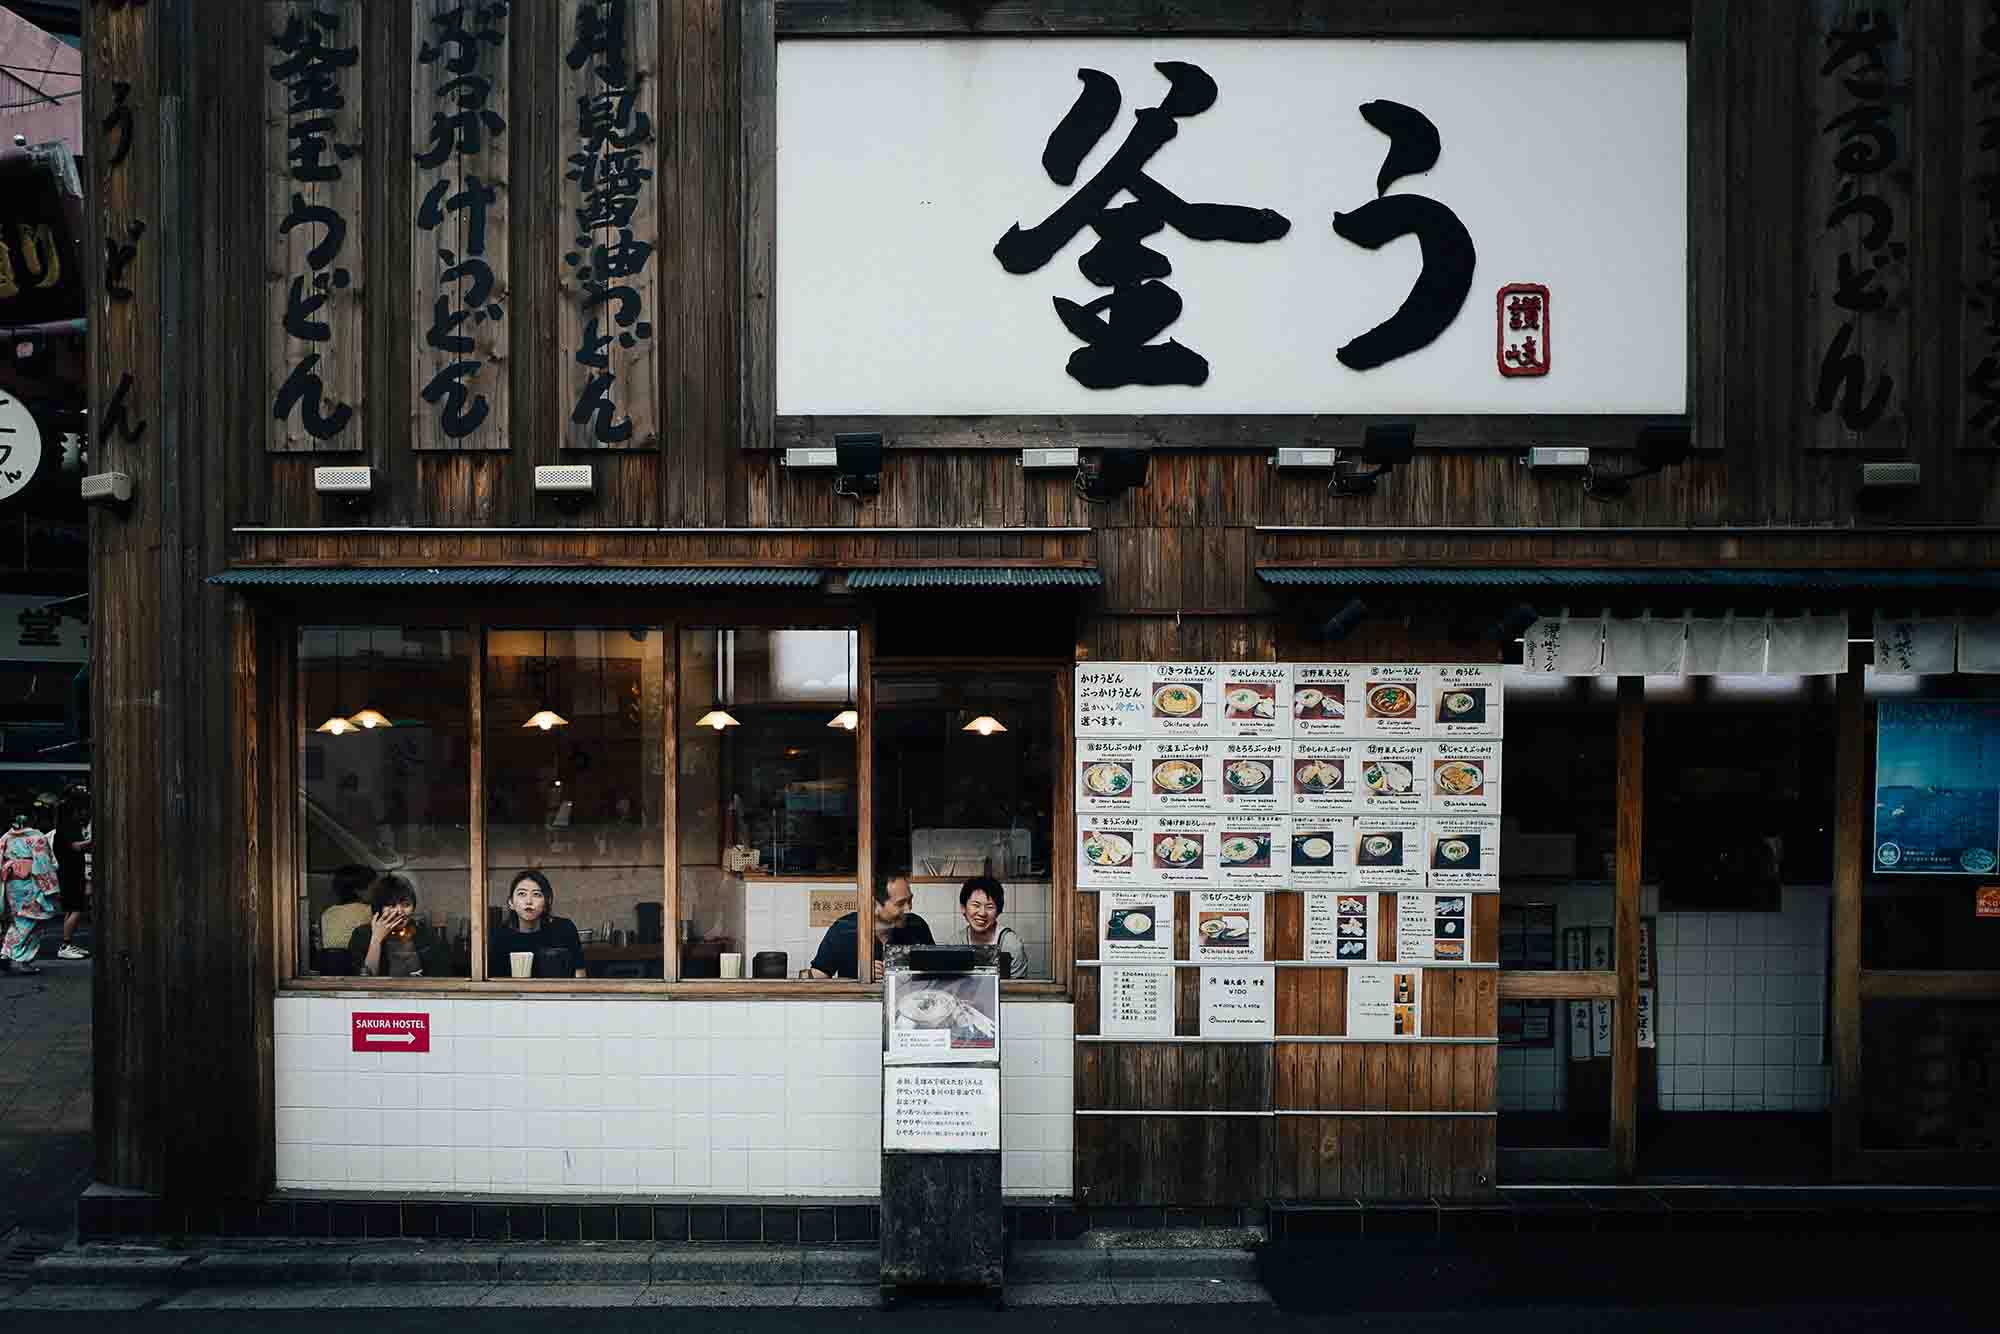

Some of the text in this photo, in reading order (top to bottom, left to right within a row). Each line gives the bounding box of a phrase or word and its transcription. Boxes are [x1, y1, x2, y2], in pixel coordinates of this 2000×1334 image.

[270, 9, 360, 440] 釜玉うどん
[1080, 673, 1124, 684] かけうどん
[1080, 687, 1142, 698] ぶっかけうどん
[356, 1019, 425, 1029] SAKURA HOSTEL
